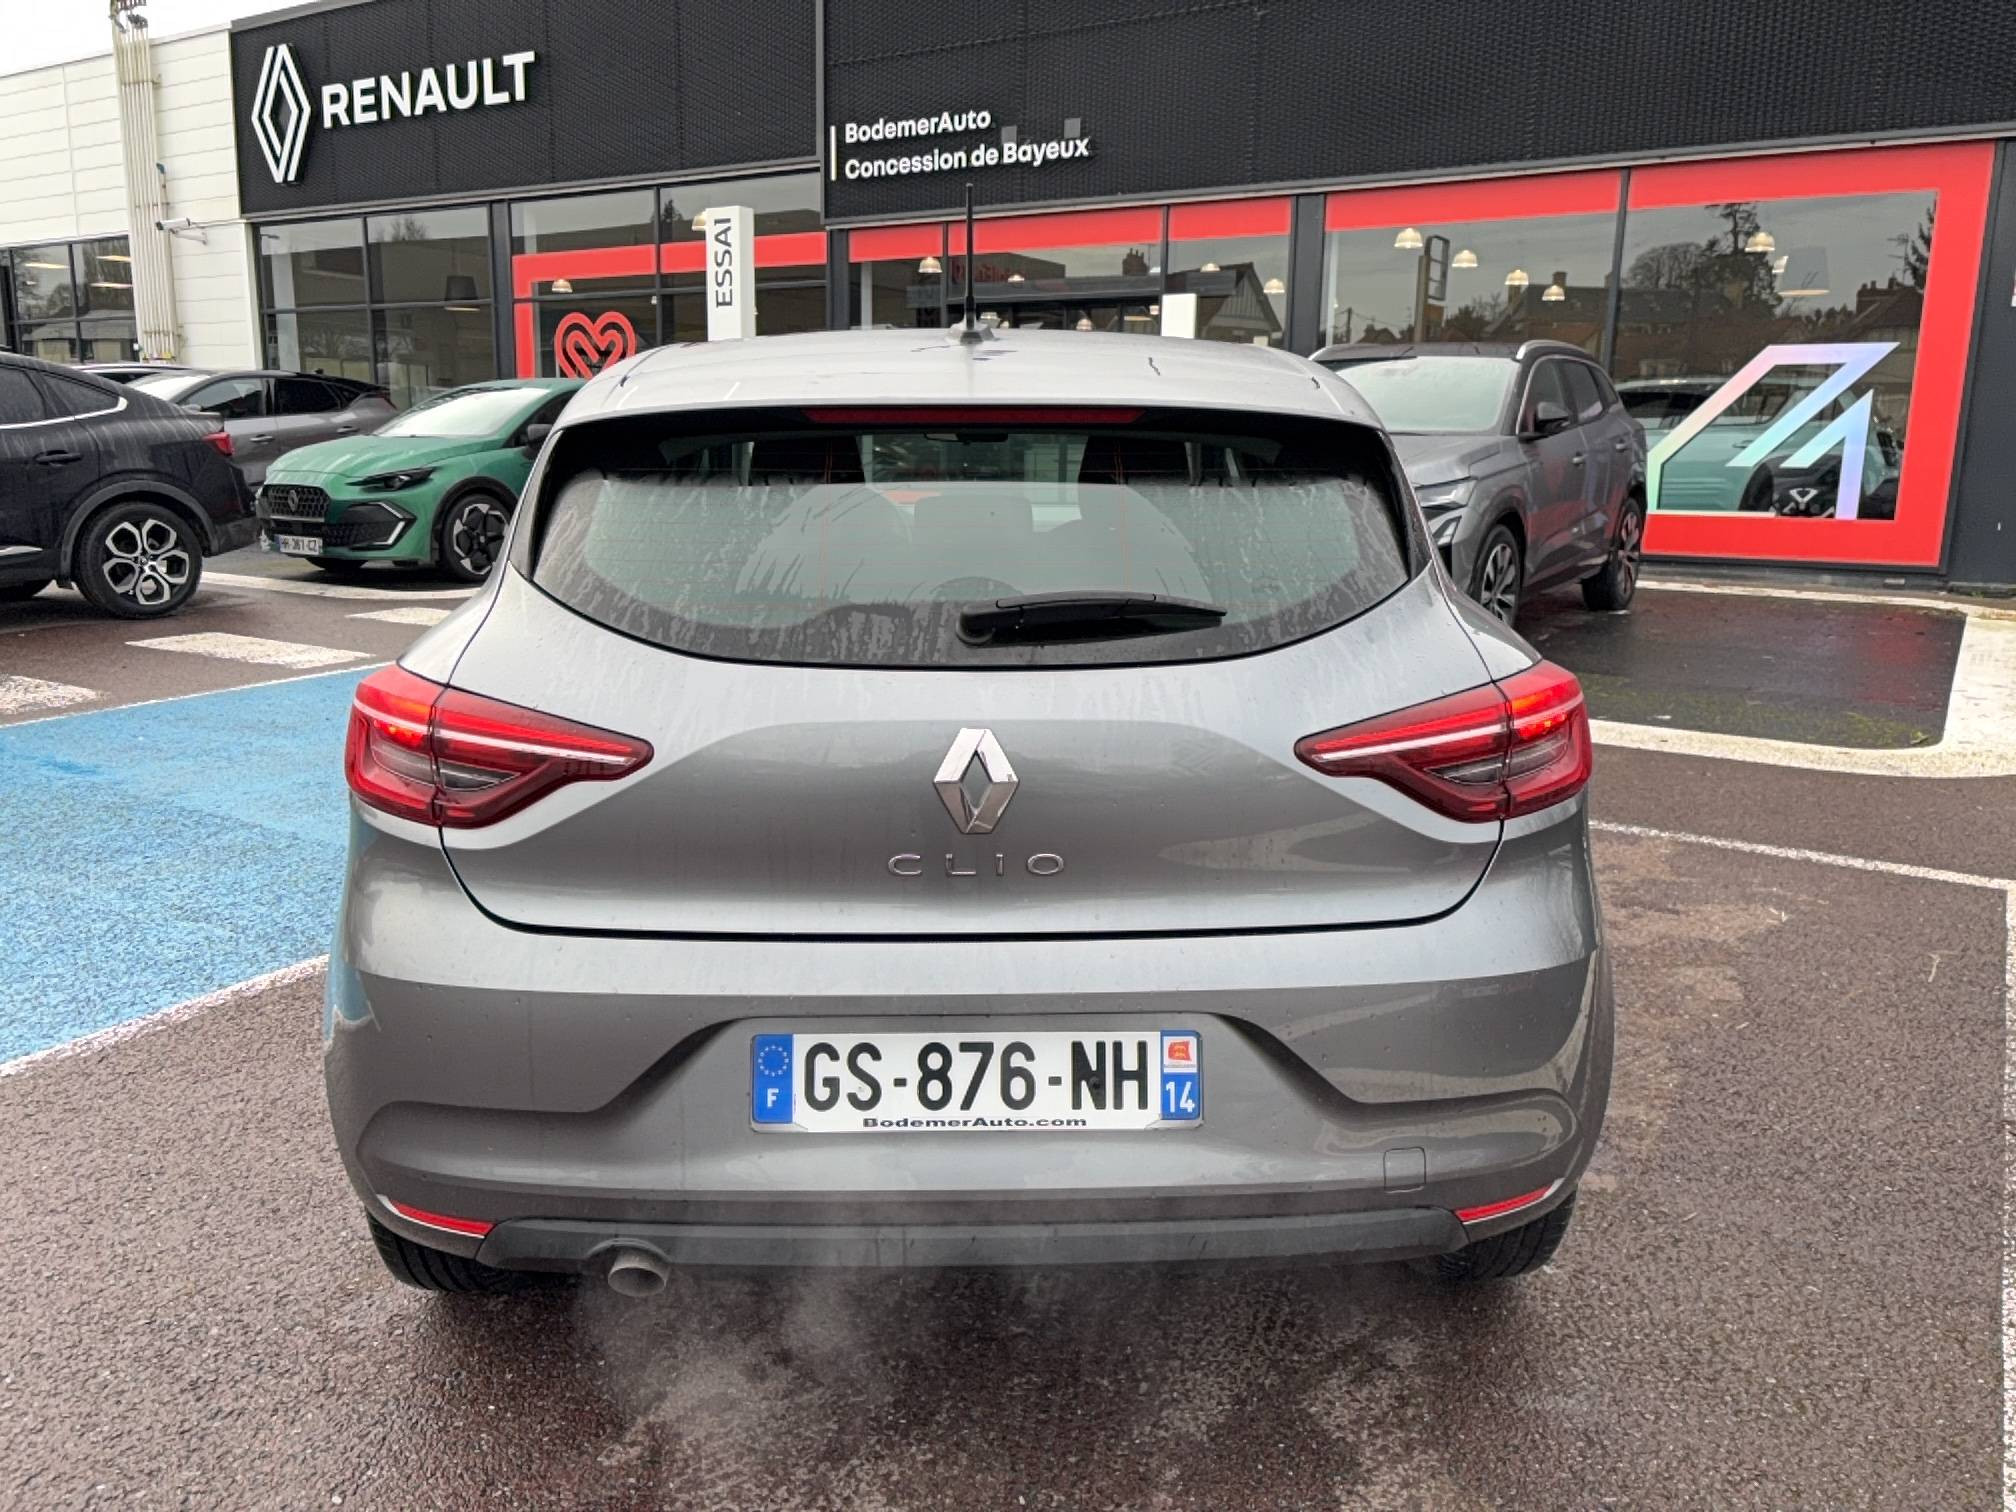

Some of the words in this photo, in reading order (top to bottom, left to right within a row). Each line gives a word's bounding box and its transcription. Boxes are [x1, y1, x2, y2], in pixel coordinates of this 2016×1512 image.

[321, 50, 536, 129] RENAULT
[844, 109, 992, 144] BodemerAuto
[844, 148, 968, 180] Concession
[970, 143, 999, 168] de
[1002, 135, 1091, 168] Bayeux
[713, 217, 733, 308] ESSAI
[887, 853, 1065, 876] CLIO
[803, 1040, 1149, 1112] GS-876-NH
[766, 1088, 780, 1108] F
[1165, 1081, 1196, 1113] 14
[862, 1117, 1088, 1128] BodemerAuto.com
